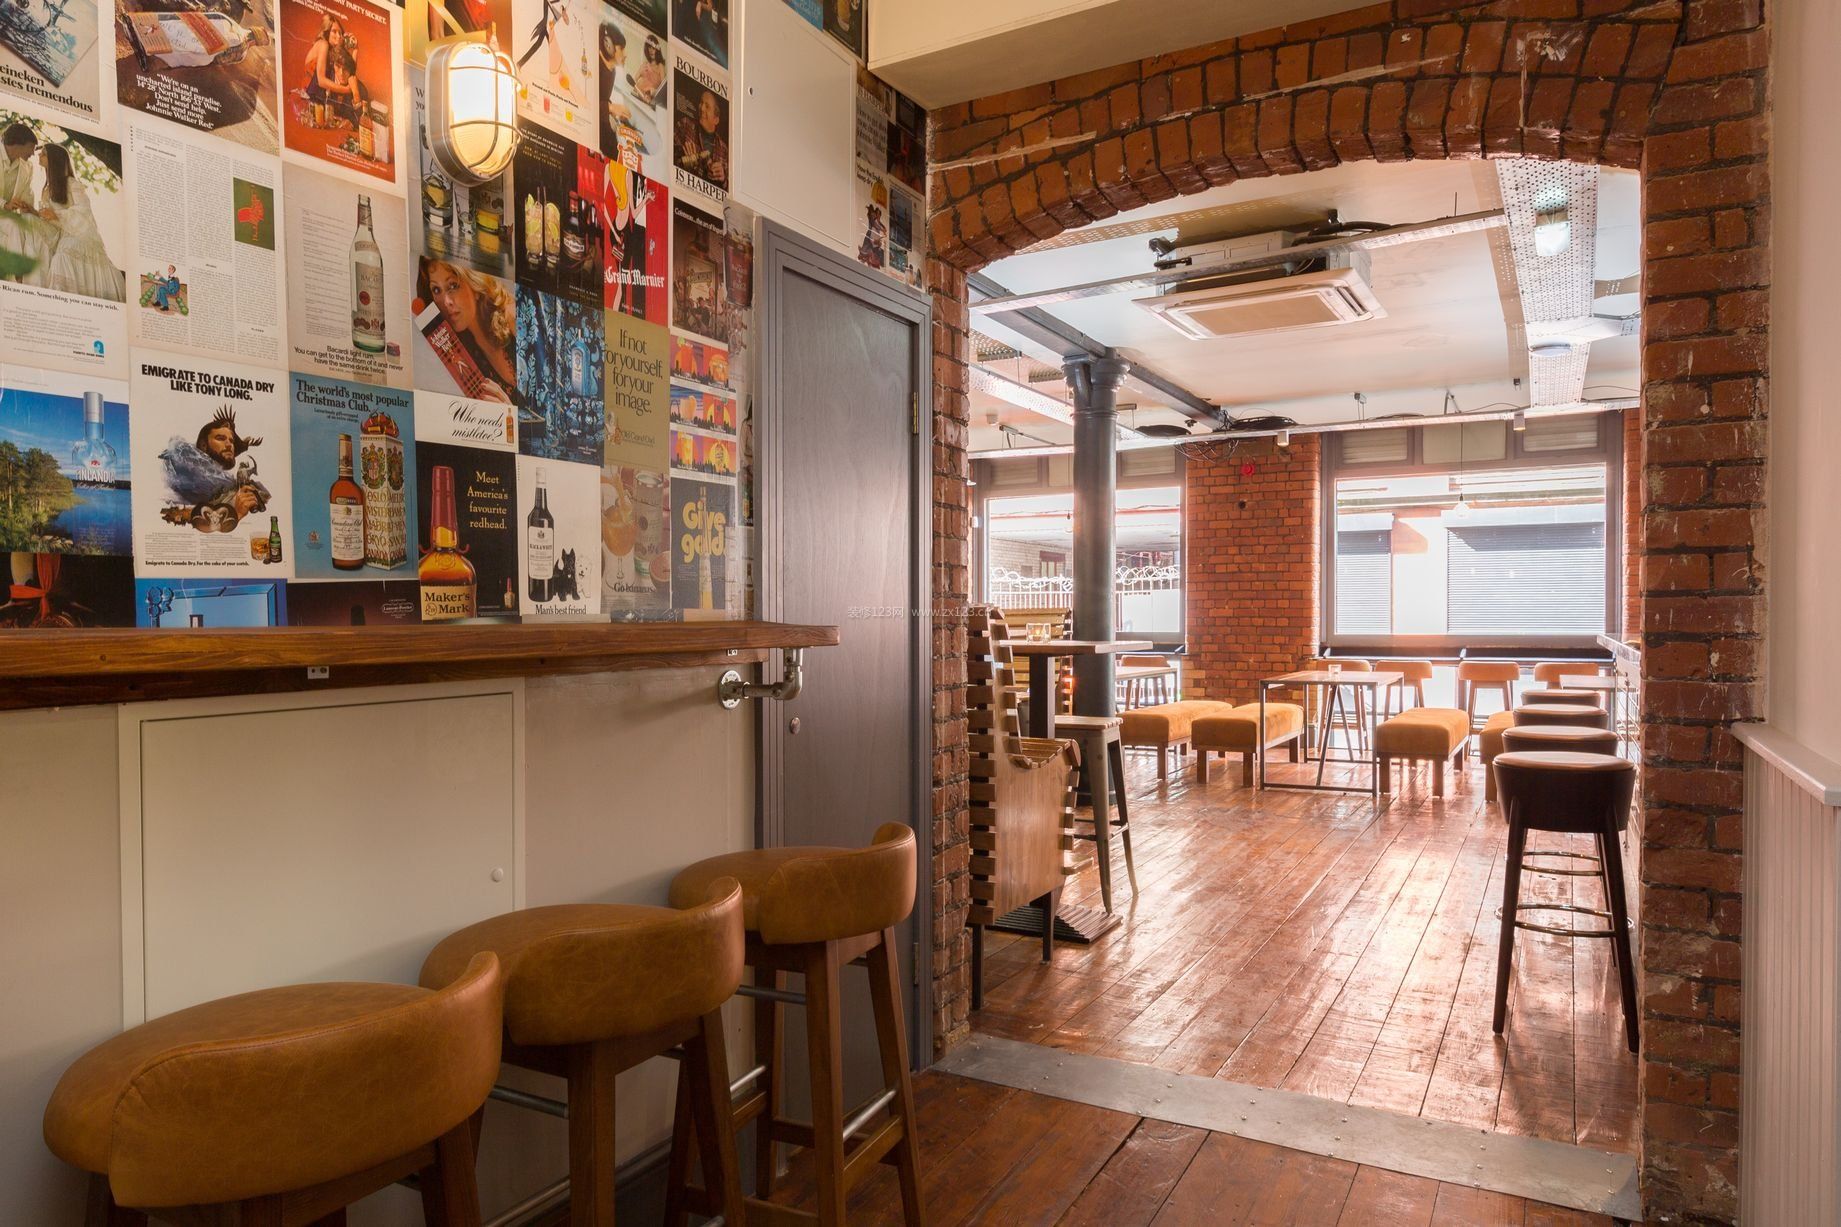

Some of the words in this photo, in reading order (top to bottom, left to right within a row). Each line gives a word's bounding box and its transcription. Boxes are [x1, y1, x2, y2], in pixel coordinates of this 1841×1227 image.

[0, 64, 44, 87] eineken
[676, 56, 728, 98] BOURBON
[0, 76, 24, 90] stes
[26, 83, 93, 113] tremendous
[136, 74, 171, 90] uncharted
[172, 85, 192, 97] island
[194, 93, 222, 107] paradise.
[190, 85, 198, 93] an
[154, 92, 173, 104] Don't
[174, 100, 190, 109] send
[158, 86, 178, 99] North
[203, 102, 221, 113] West.
[146, 102, 172, 116] Johnnie
[174, 110, 197, 125] Walker
[156, 100, 170, 109] Just
[171, 105, 186, 114] send
[188, 110, 204, 120] more
[676, 168, 684, 182] IS
[604, 266, 632, 284] Grand
[632, 268, 664, 288] Marnier
[37, 291, 68, 302] Something
[93, 302, 104, 310] stay
[326, 346, 348, 354] Bacardi
[350, 348, 362, 358] light
[620, 329, 628, 348] If
[628, 337, 647, 355] not
[294, 346, 305, 354] You
[318, 351, 328, 359] get
[346, 356, 366, 364] bottom
[356, 364, 369, 372] drink
[142, 364, 196, 382] EMIGRATE
[198, 372, 211, 384] TO
[213, 375, 253, 390] CANADA
[256, 381, 274, 393] DRY
[613, 367, 628, 388] for
[628, 376, 654, 394] your
[170, 380, 192, 392] LIKE
[194, 383, 222, 396] TONY
[224, 388, 252, 400] LONG.
[296, 379, 315, 392] The
[318, 384, 350, 398] world's
[352, 392, 374, 402] most
[376, 394, 408, 408] popular
[296, 391, 346, 408] Christmas
[348, 400, 371, 412] Club.
[616, 387, 652, 416] image.
[448, 400, 476, 423] Who
[478, 412, 504, 428] needs
[452, 428, 502, 442] mistletoe?
[476, 471, 498, 484] Meet
[467, 486, 508, 500] America's
[470, 501, 507, 514] favourite
[682, 500, 726, 530] Give
[470, 517, 507, 529] redhead.
[681, 531, 726, 564] gold.
[425, 592, 470, 602] Maker's
[438, 604, 469, 614] Mark
[536, 604, 554, 614] Man's
[555, 604, 568, 615] best
[568, 604, 586, 615] friend
